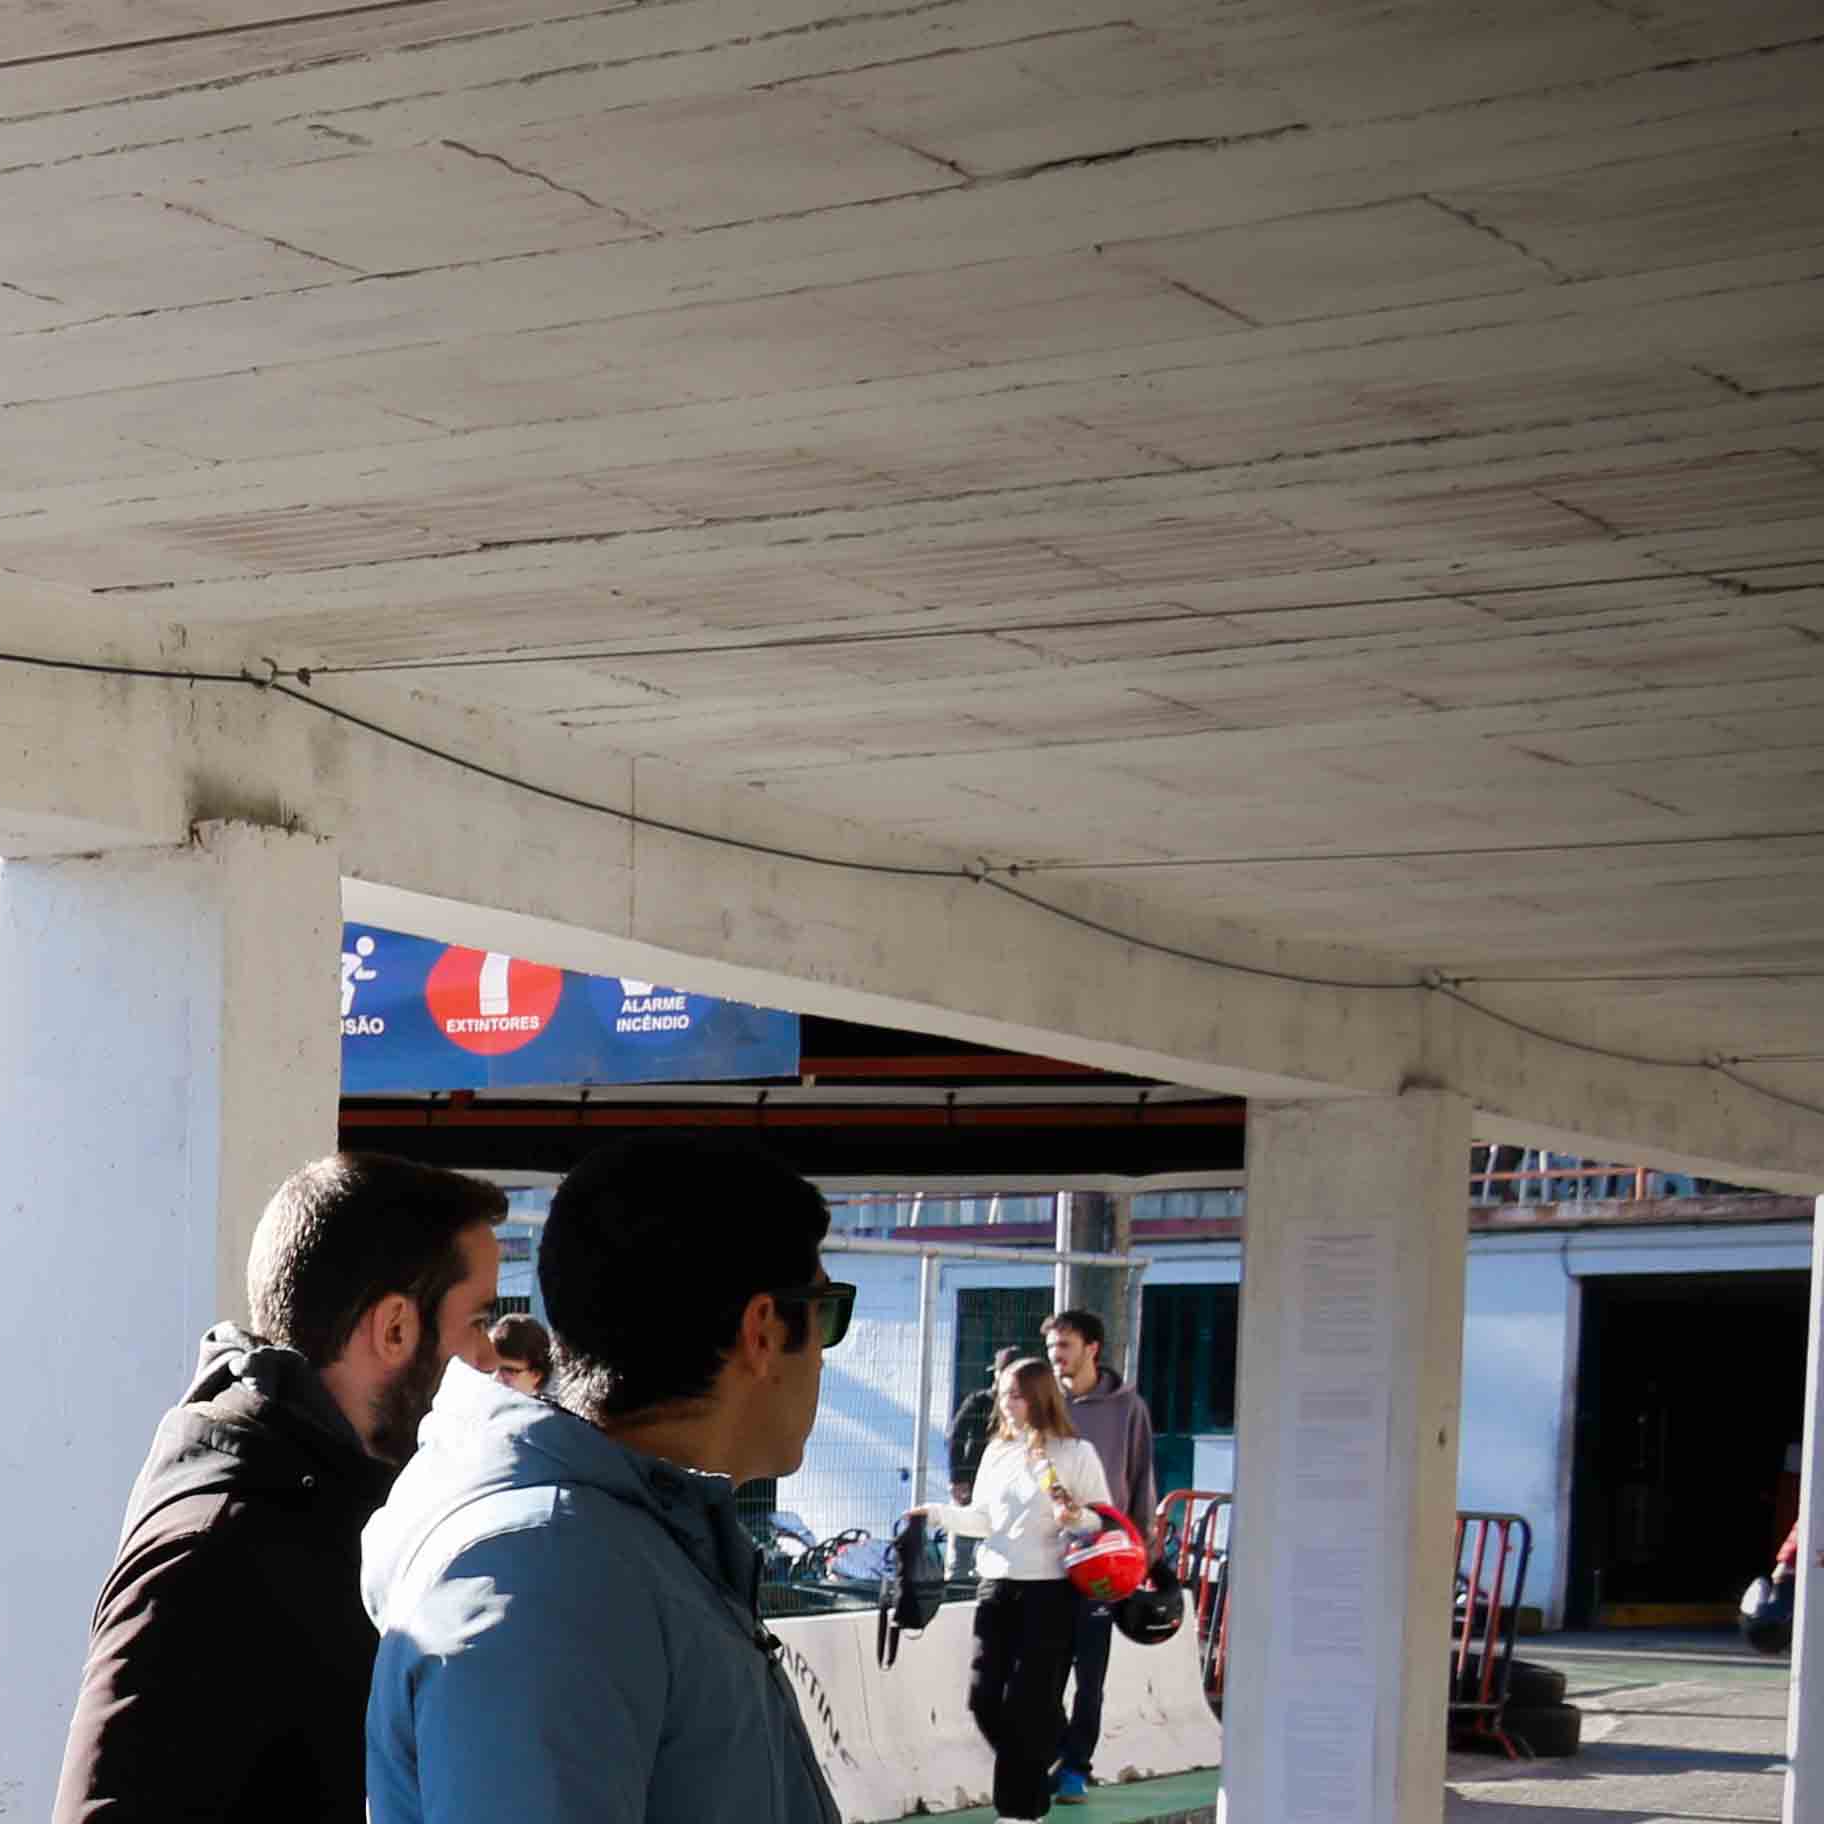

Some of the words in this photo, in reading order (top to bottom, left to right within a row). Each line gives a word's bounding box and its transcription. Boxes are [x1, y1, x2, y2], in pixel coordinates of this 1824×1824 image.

[621, 996, 686, 1014] ALARME
[341, 1015, 385, 1035] SÃO
[446, 1015, 541, 1034] EXTINTORES
[616, 1013, 690, 1033] INCÊNDIO
